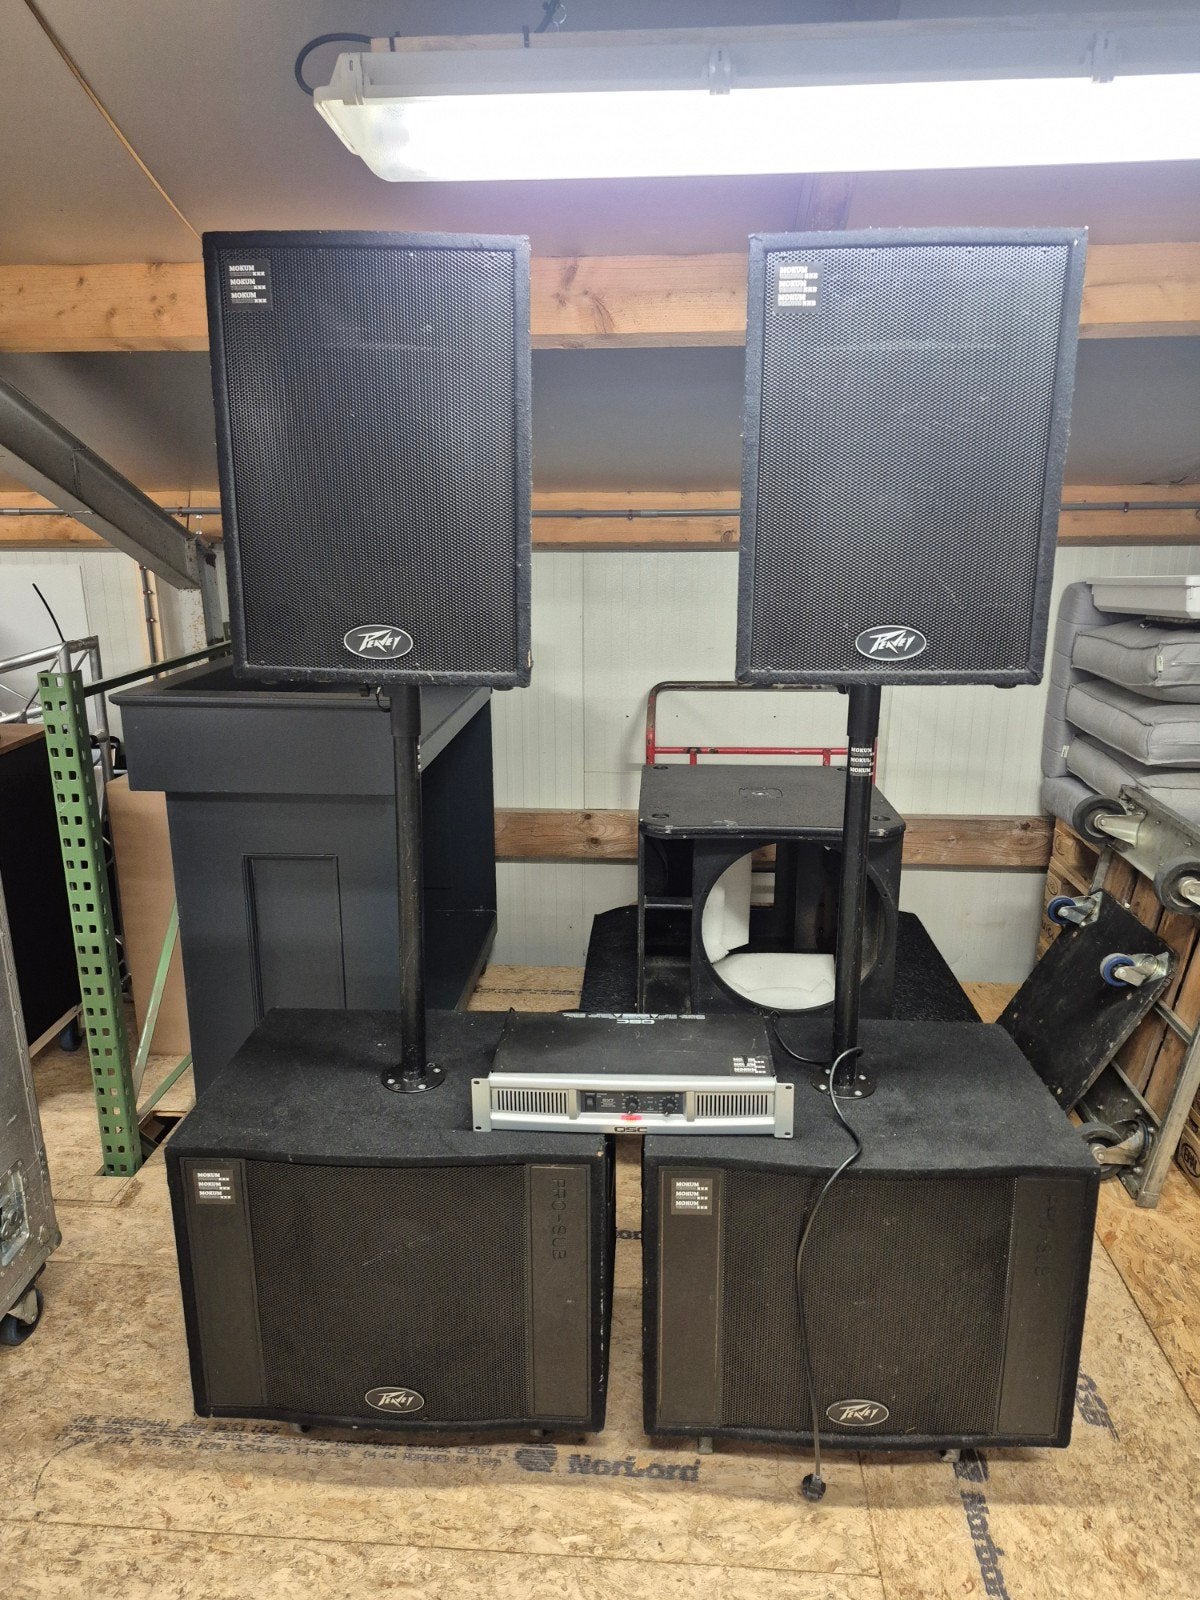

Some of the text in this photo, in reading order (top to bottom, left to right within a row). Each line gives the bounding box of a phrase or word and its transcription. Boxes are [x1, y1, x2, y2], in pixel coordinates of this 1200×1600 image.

[357, 629, 402, 652] PEAVEY
[869, 629, 916, 654] PEAVEY
[551, 1178, 567, 1260] PRO-SUB
[377, 1390, 415, 1408] PEAVEY
[839, 1403, 879, 1421] PEAVEY
